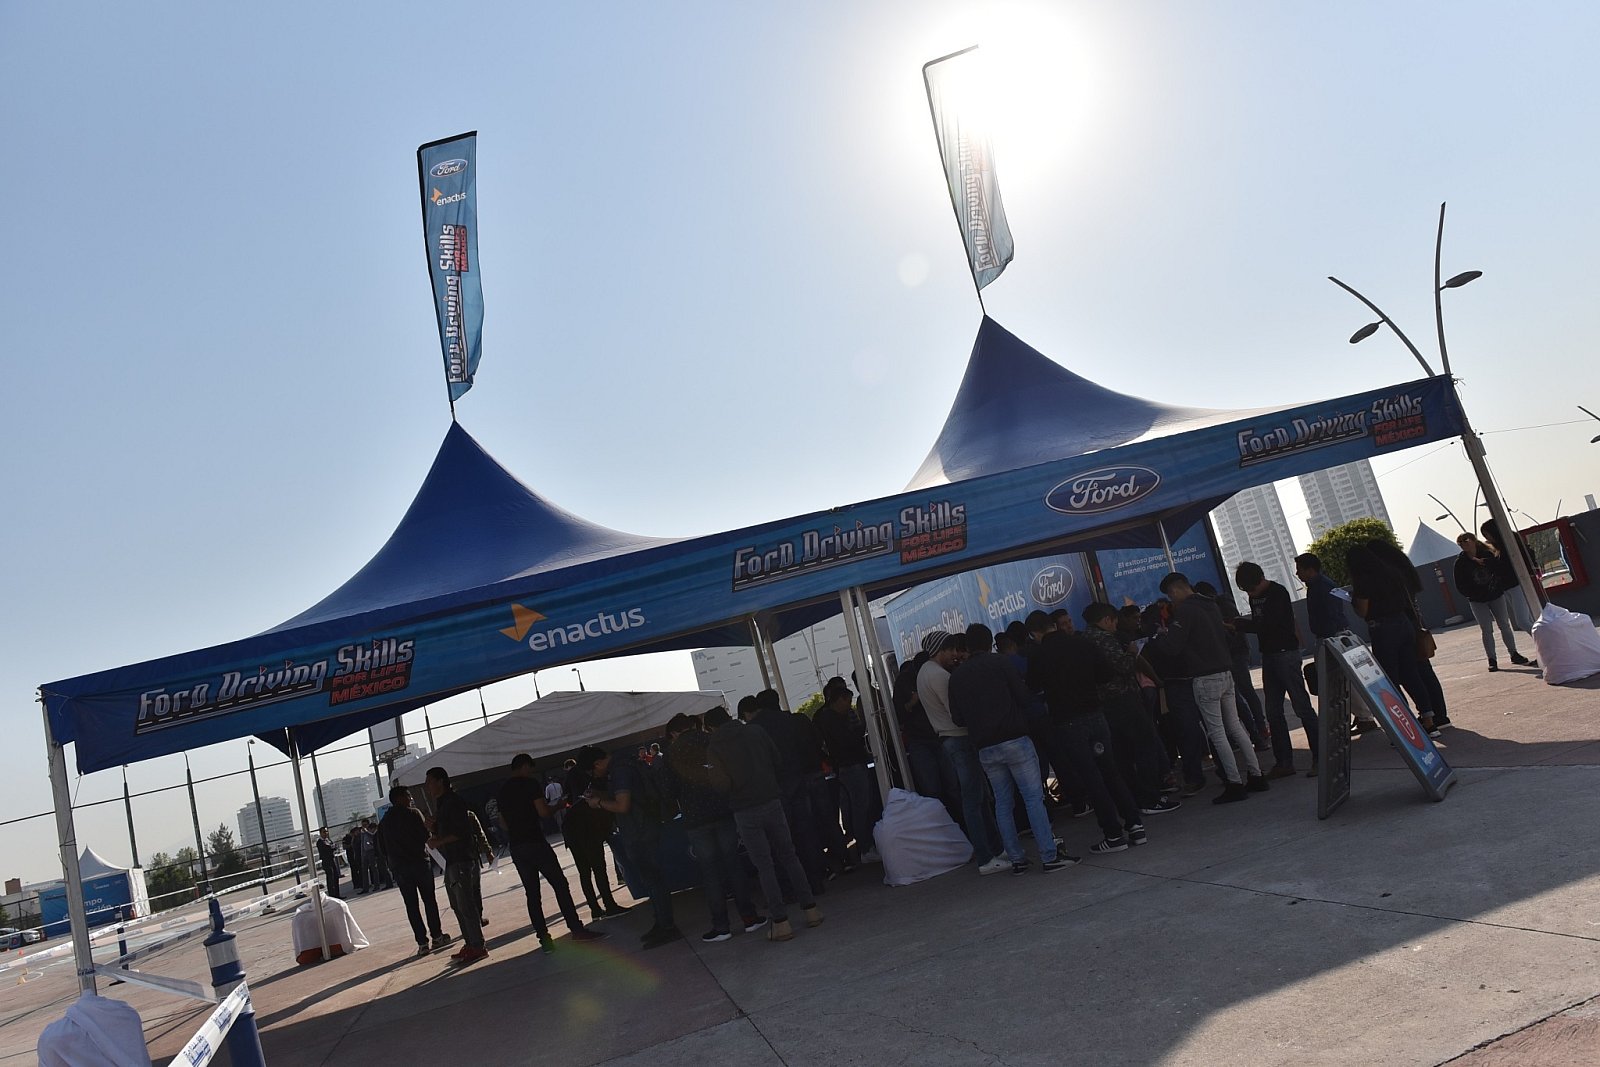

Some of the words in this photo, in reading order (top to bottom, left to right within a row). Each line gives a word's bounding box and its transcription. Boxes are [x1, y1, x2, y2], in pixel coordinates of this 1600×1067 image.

[437, 160, 461, 176] Ford
[436, 191, 467, 206] enactus
[439, 224, 455, 270] Skills
[443, 275, 459, 338] Driving
[1291, 410, 1369, 443] Driving
[1371, 394, 1422, 425] Skills
[1069, 472, 1140, 509] Ford
[803, 519, 894, 562] Driving
[900, 501, 965, 538] Skills
[902, 533, 930, 550] FOR
[932, 525, 963, 541] LIFE
[1178, 546, 1197, 557] global
[1192, 552, 1206, 560] Ford
[1038, 570, 1066, 601] Ford
[988, 590, 1026, 620] enactus
[528, 607, 646, 651] enactus
[217, 659, 328, 702] Driving
[335, 638, 415, 676] Skills
[332, 671, 369, 688] FOR
[370, 662, 408, 680] LIFE
